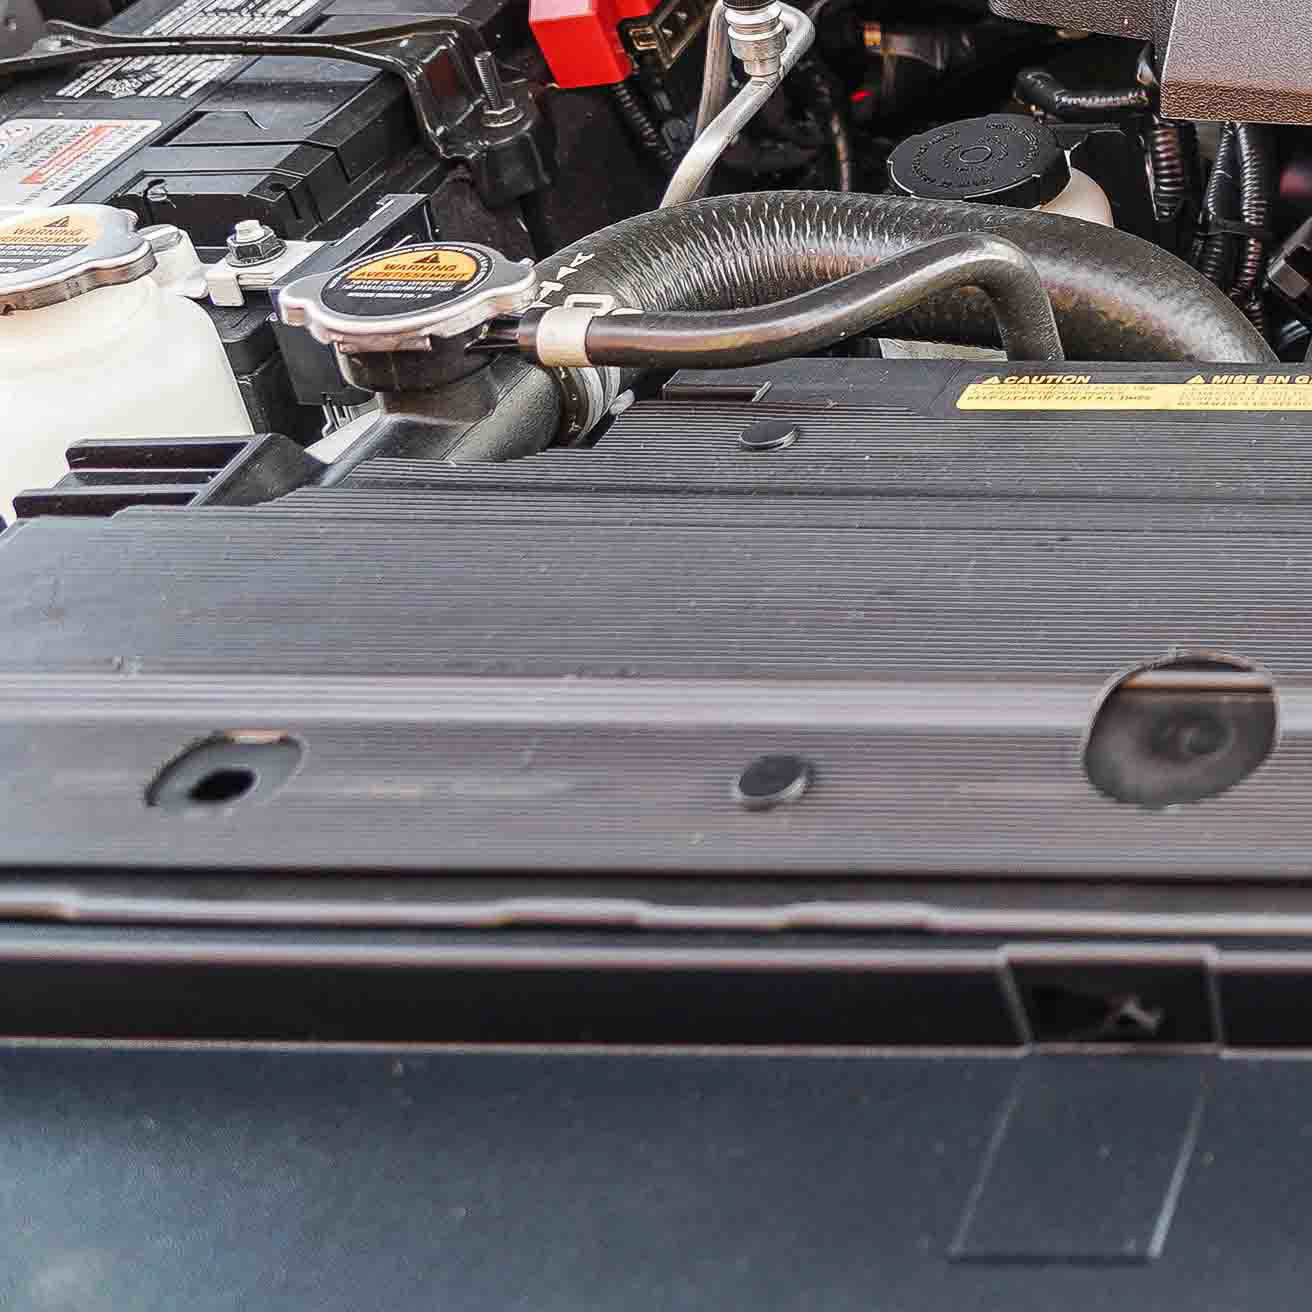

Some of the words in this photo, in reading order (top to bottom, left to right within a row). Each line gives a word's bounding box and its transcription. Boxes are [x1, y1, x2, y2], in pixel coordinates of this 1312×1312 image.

[383, 263, 457, 272] WARNING
[1003, 375, 1092, 385] CAUTION
[1263, 375, 1291, 385] EN
